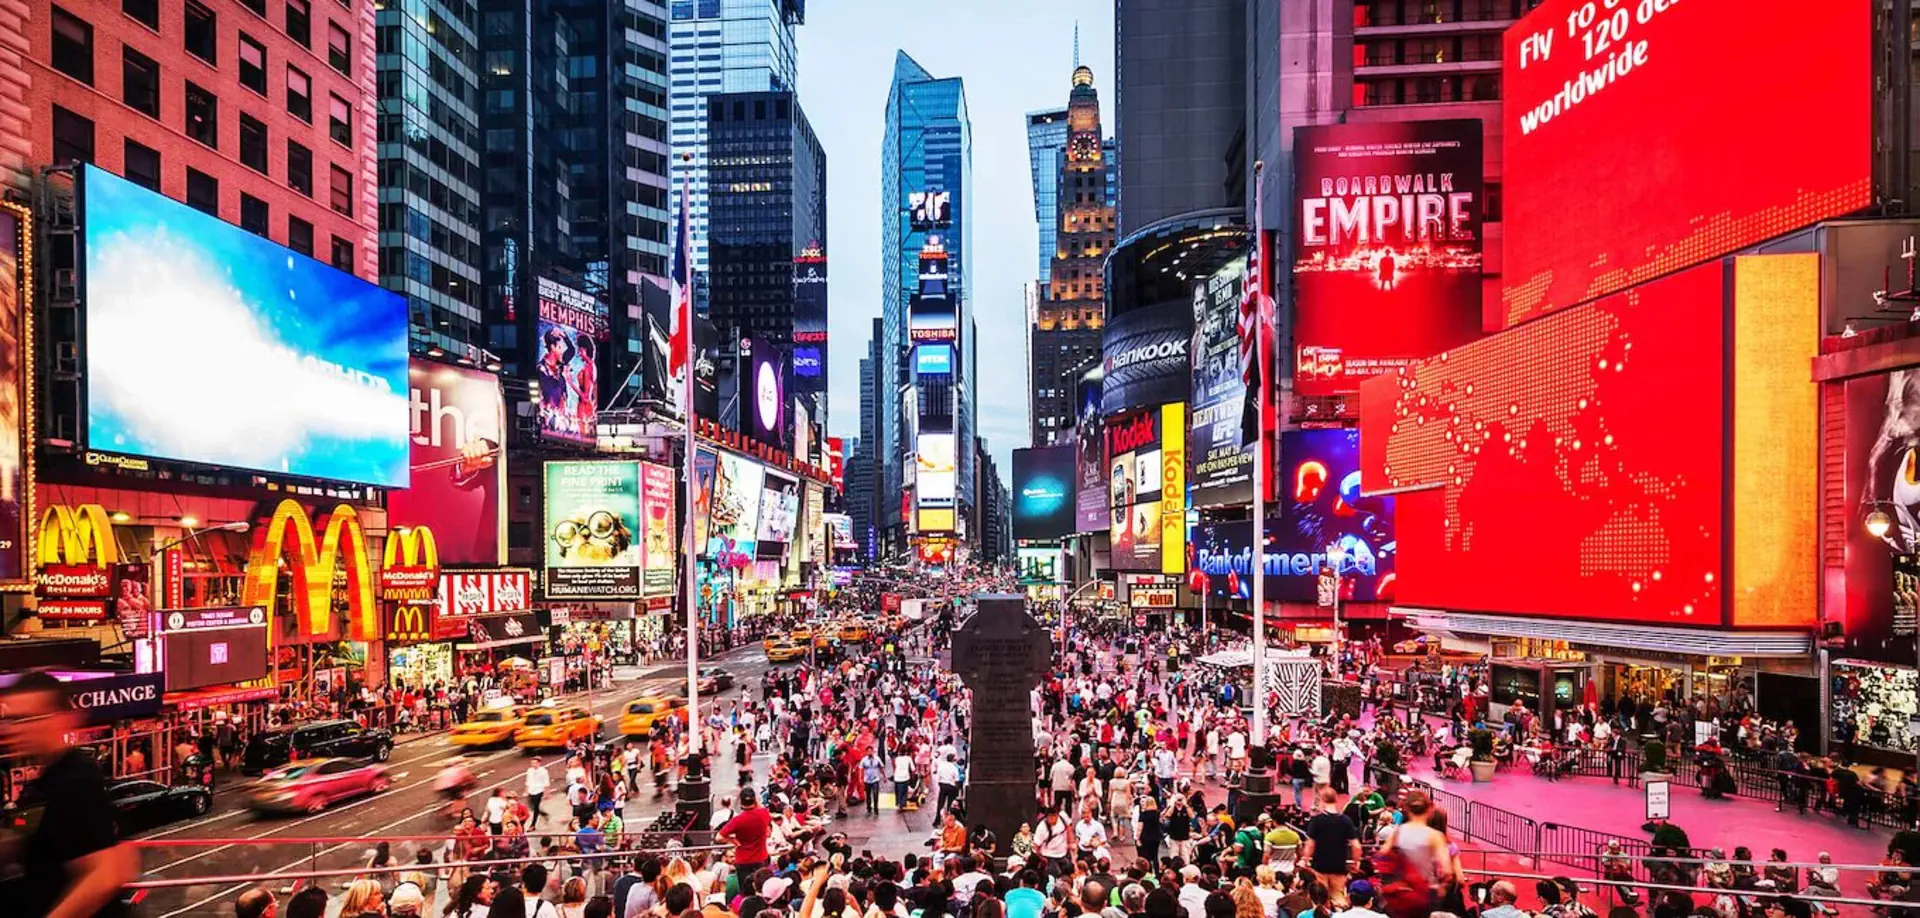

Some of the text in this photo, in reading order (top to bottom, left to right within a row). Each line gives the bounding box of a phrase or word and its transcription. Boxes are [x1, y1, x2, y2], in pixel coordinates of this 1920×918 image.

[1520, 2, 1596, 69] Fly to
[1582, 8, 1629, 61] 120
[1520, 40, 1648, 135] worldwide
[1321, 173, 1453, 197] BOARDWALK
[1303, 192, 1473, 246] EMPIRE
[538, 285, 560, 300] BEST
[561, 294, 595, 313] MUSICAL
[540, 299, 595, 334] MEMPHIS
[912, 330, 955, 338] TOSHIBA
[1113, 411, 1154, 452] Kodak
[1213, 422, 1235, 441] UFC
[564, 465, 621, 475] READ THE
[562, 477, 623, 487] FINE PRINT
[1163, 450, 1182, 530] Kodak
[1198, 548, 1233, 574] Bank
[1234, 547, 1251, 574] of
[36, 573, 108, 585] McDonald's
[383, 572, 434, 580] McDonald's
[47, 585, 96, 593] Restaurant
[551, 585, 638, 594] HUMANEWATCH.ORG
[1149, 594, 1174, 605] EVITA
[38, 606, 103, 614] OPEN 24 HOURS
